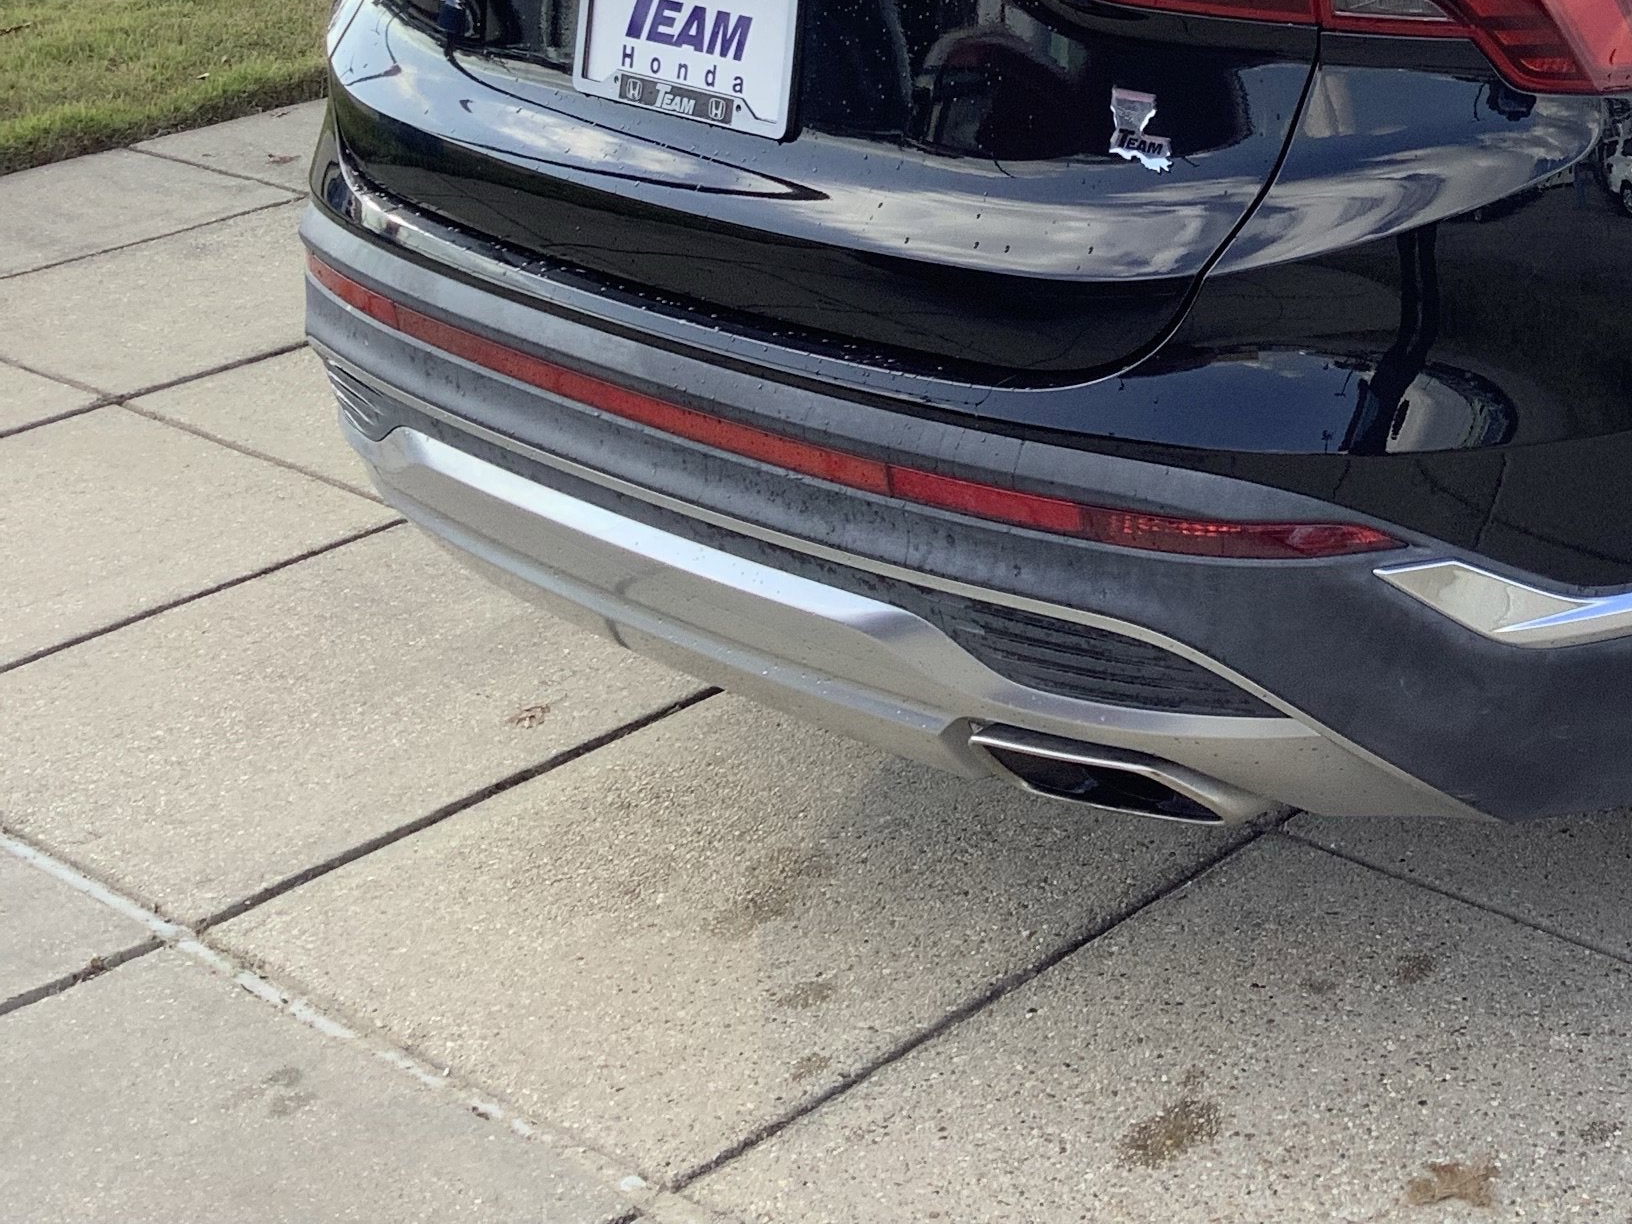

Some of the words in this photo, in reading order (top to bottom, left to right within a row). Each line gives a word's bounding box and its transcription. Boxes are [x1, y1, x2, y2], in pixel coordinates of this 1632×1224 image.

[621, 44, 744, 95] Honda
[654, 84, 696, 116] TEAM
[1118, 127, 1164, 156] TEAM
